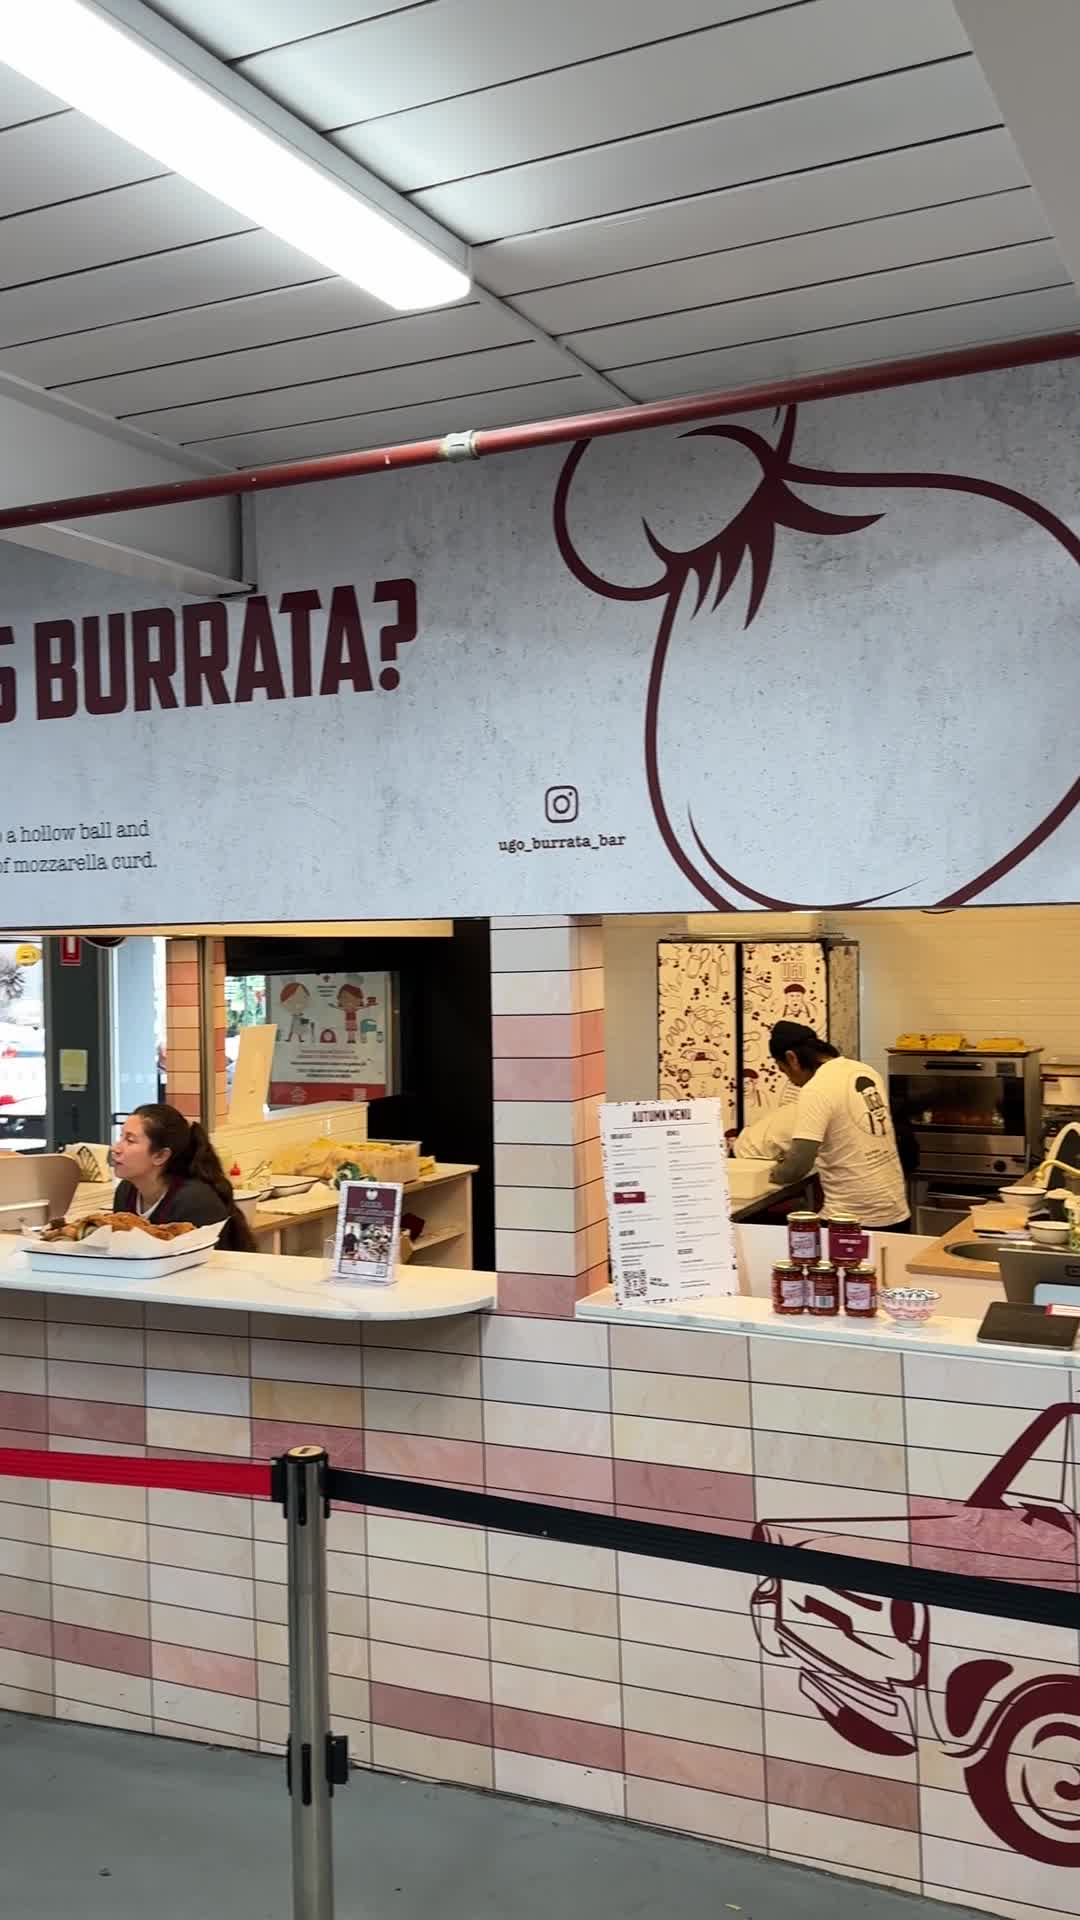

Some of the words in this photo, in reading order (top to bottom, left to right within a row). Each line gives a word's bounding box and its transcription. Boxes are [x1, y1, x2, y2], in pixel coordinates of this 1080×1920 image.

[34, 578, 418, 721] BURRATA?
[6, 829, 17, 843] a
[20, 825, 76, 842] hollow
[79, 822, 113, 840] ball
[116, 819, 150, 837] and
[498, 834, 627, 854] ugo_burrata_bar
[13, 854, 108, 873] mozzarella
[112, 851, 158, 870] curd.
[632, 1108, 667, 1123] AUTUMN
[668, 1107, 693, 1121] MENU
